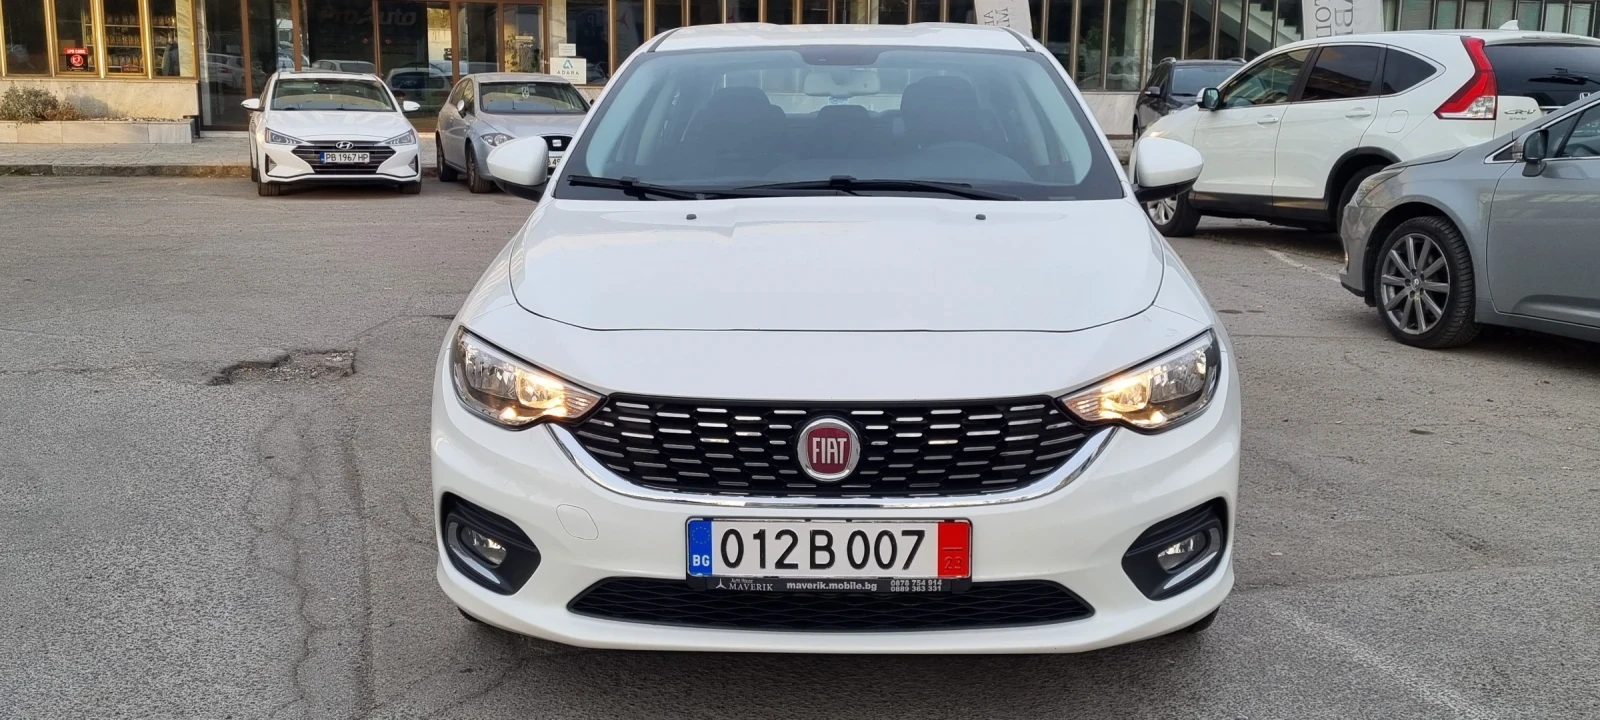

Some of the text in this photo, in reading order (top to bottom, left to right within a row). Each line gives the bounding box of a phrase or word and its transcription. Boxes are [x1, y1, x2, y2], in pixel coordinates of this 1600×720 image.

[326, 153, 369, 161] PB 1967 HP
[812, 437, 848, 465] FIAT
[720, 528, 926, 571] 012 B 007
[692, 554, 710, 567] BG
[944, 556, 963, 571] 23
[729, 582, 774, 591] MAVERIK
[786, 581, 878, 592] maverik.mobile.bg
